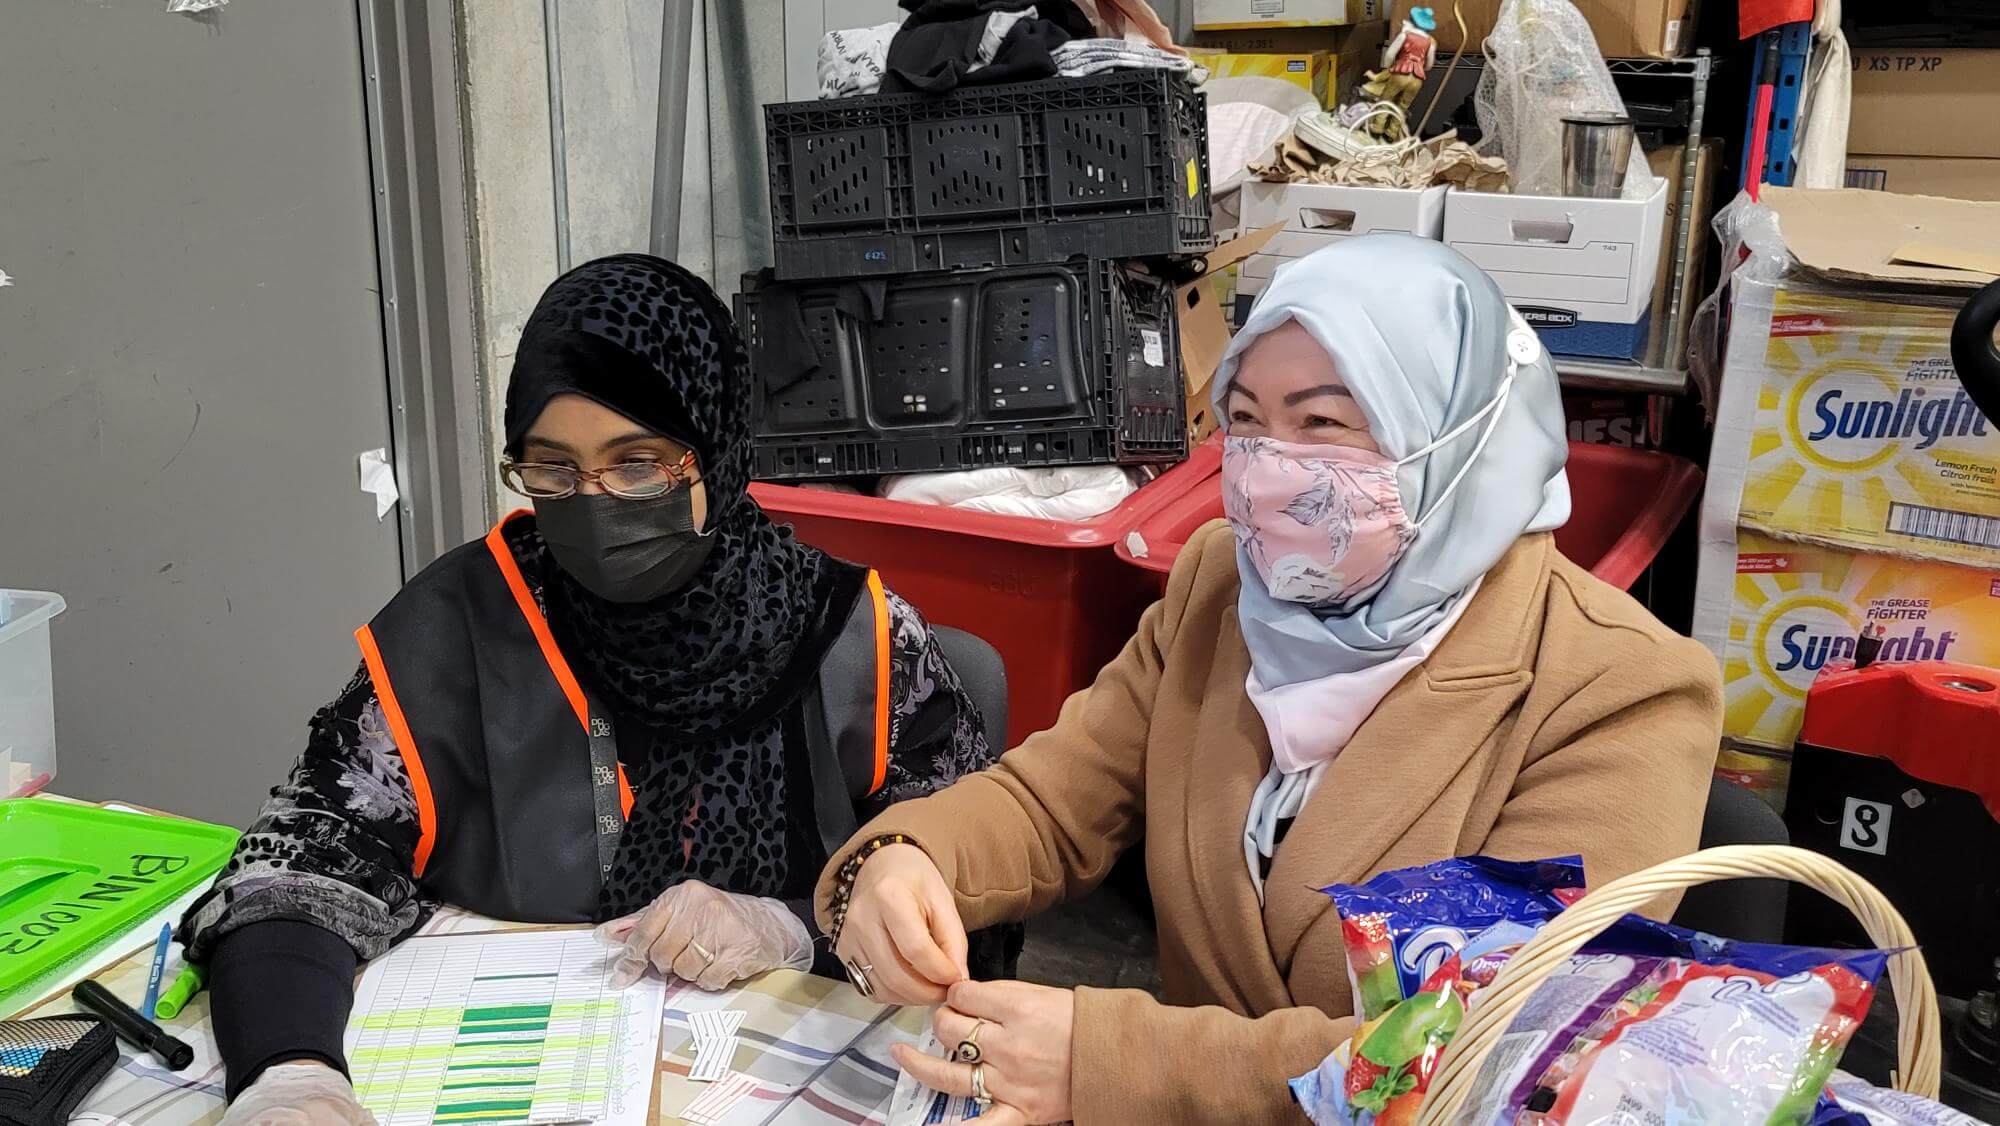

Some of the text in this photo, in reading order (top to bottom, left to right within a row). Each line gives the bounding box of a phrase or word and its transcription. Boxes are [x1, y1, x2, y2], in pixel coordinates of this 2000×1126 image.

[1869, 57, 1890, 71] XS
[1896, 57, 1916, 71] TP
[1919, 57, 1942, 71] XP
[1548, 314, 1573, 322] BOX
[1935, 459, 1997, 475] Lemon Fresh
[1940, 469, 1996, 484] Citron frais
[1887, 599, 1930, 608] GREASE
